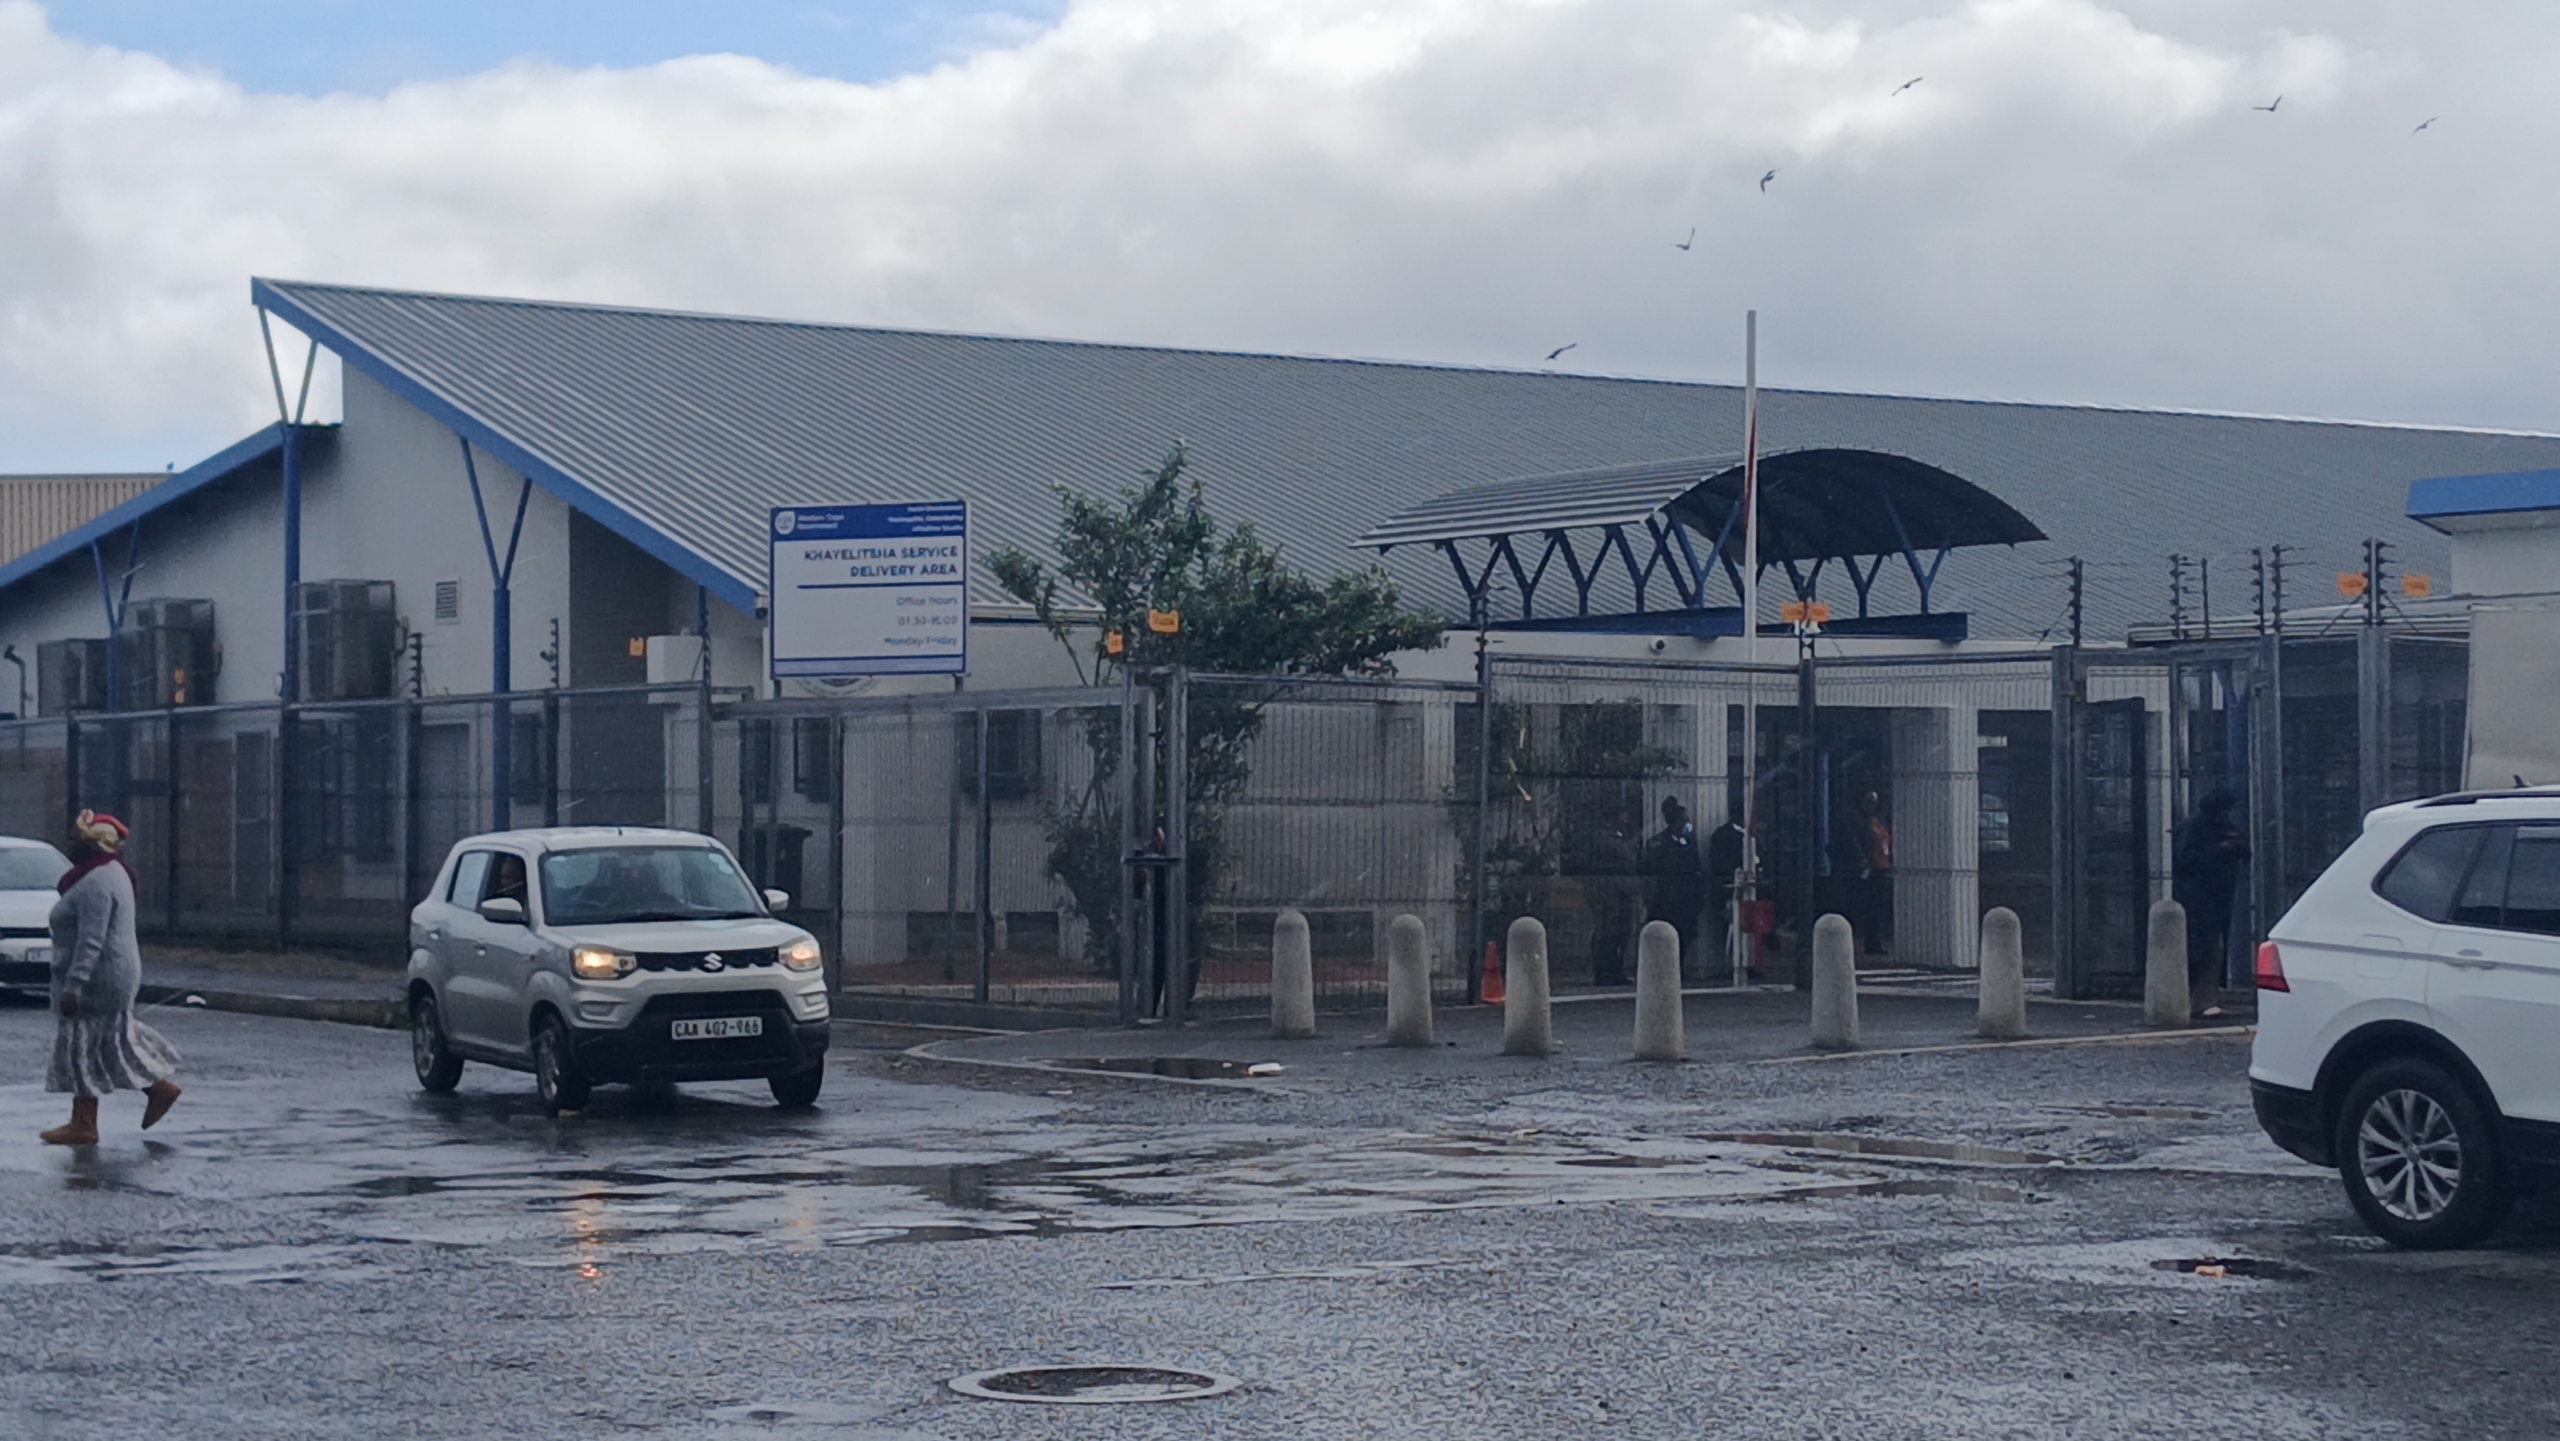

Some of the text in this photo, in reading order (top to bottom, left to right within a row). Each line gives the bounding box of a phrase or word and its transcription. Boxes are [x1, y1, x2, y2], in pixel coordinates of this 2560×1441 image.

[901, 545, 958, 559] SERVICE
[850, 563, 958, 577] DELIVERY AREA
